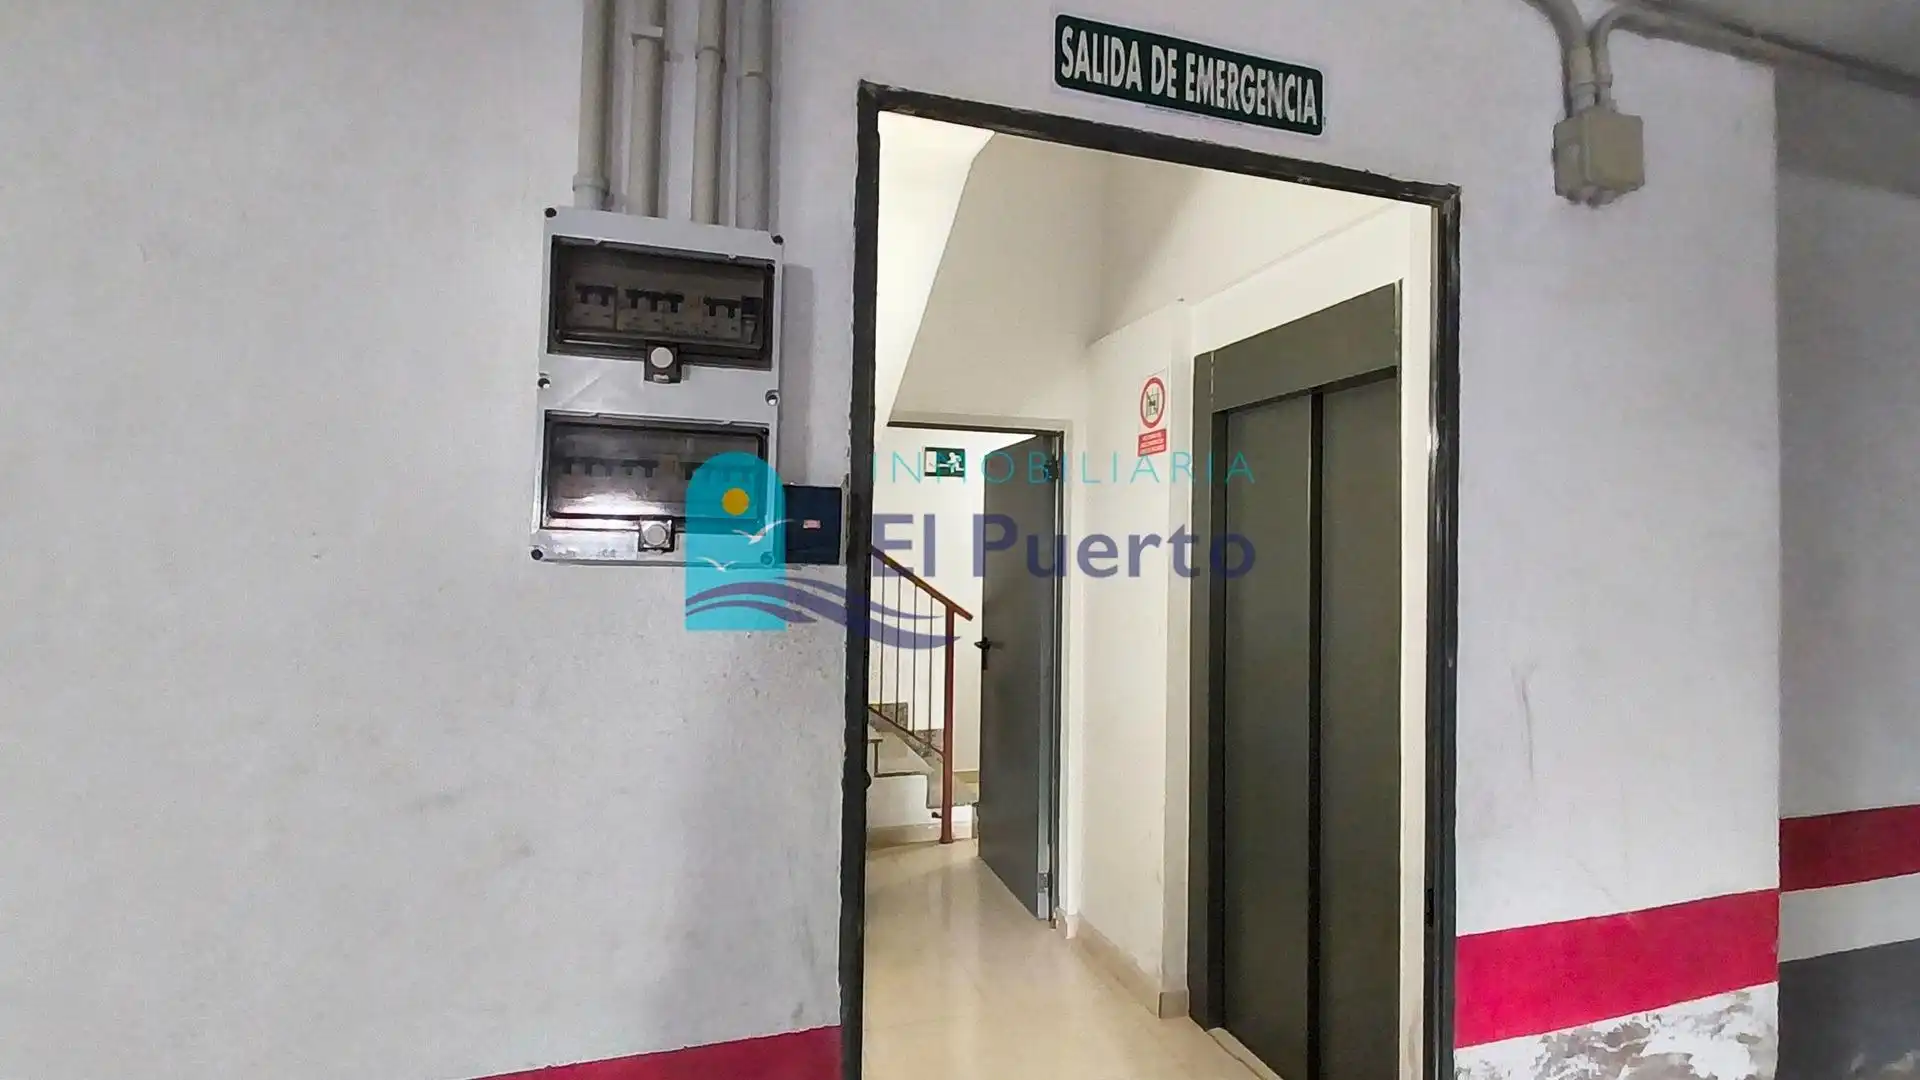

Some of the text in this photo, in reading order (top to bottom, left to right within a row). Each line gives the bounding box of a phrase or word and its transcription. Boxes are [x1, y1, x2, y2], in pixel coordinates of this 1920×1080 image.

[1061, 25, 1318, 126] SALIDA DE EMERGENCIA
